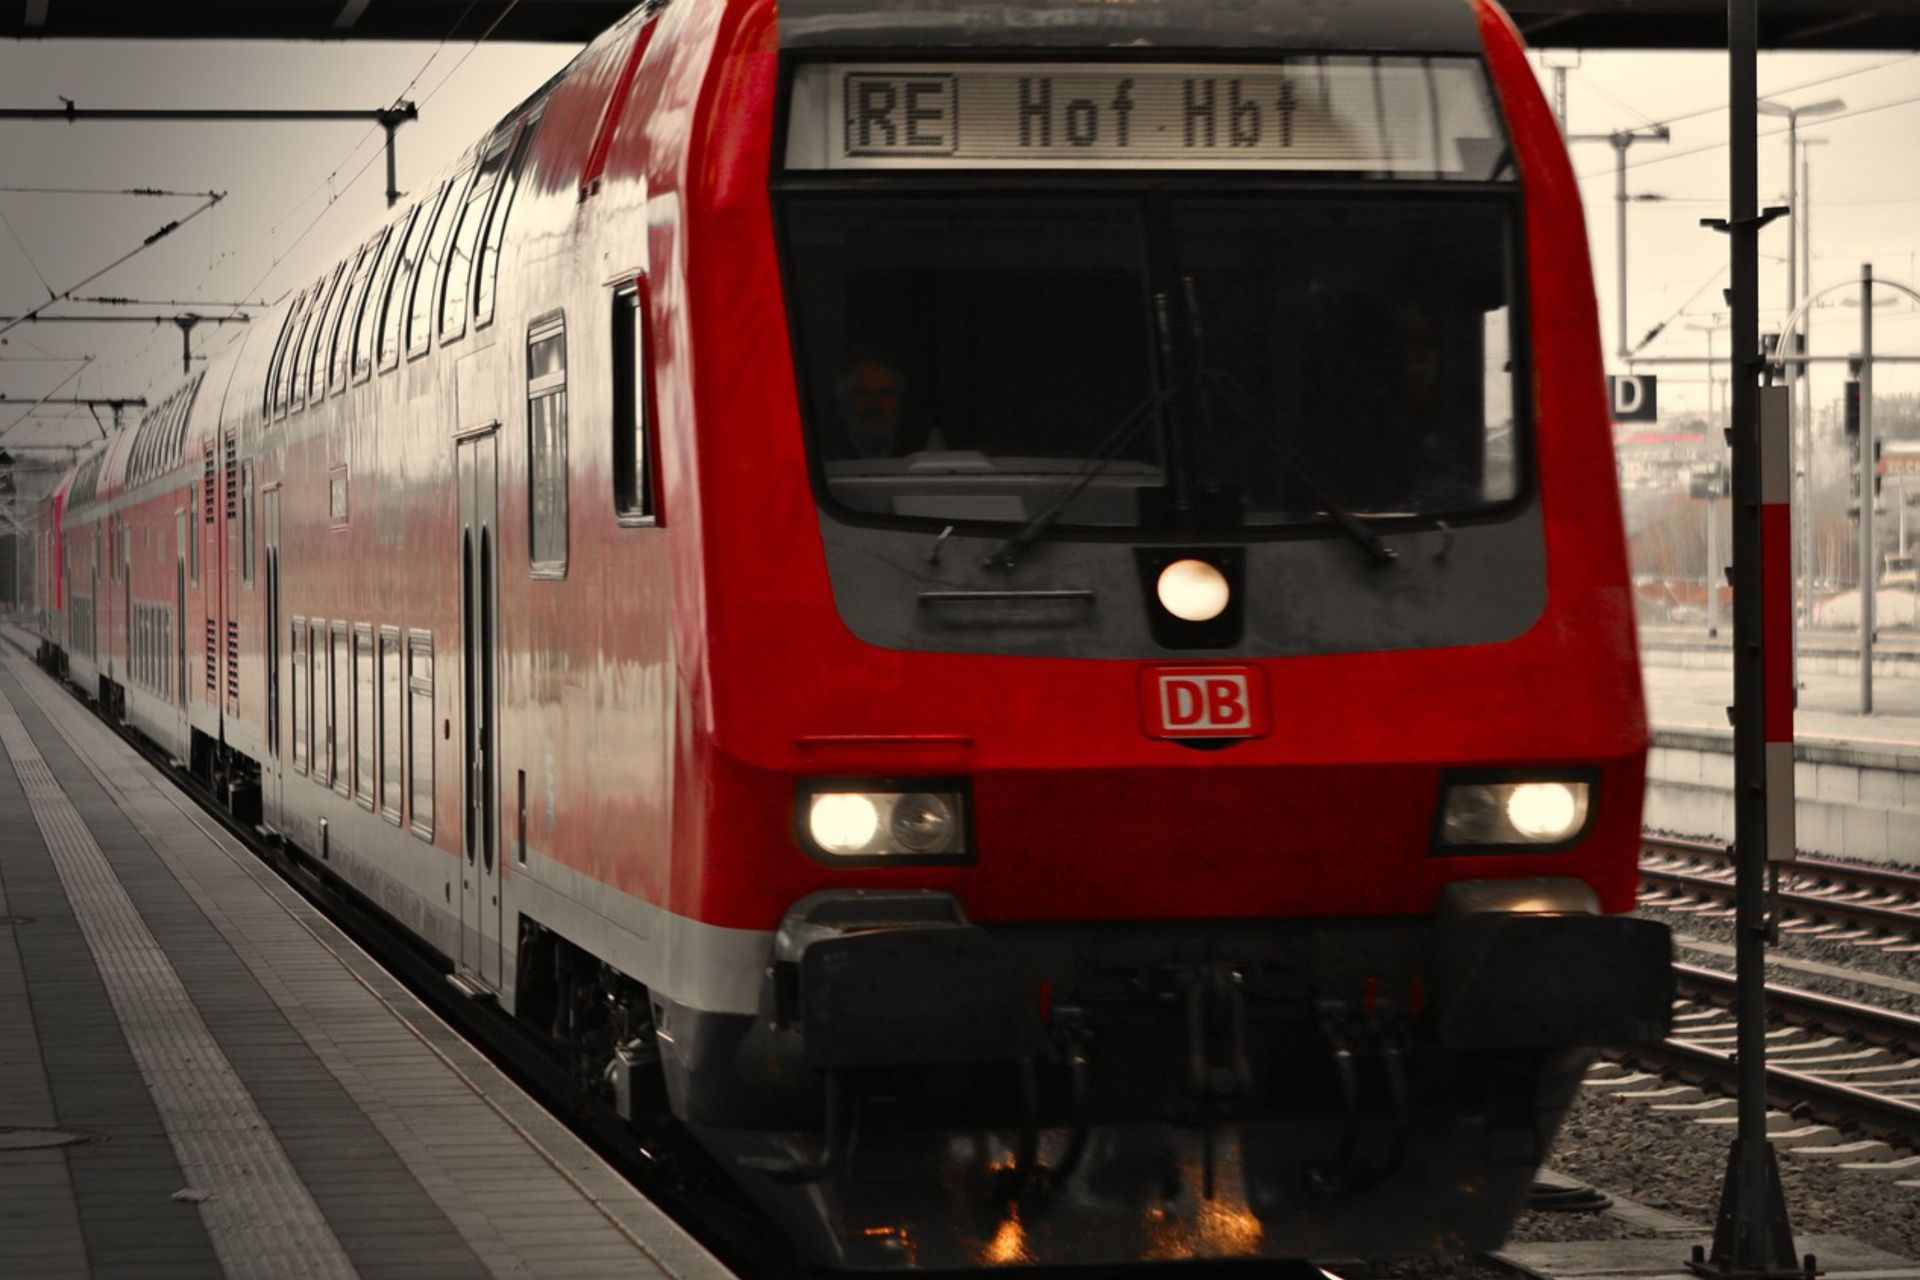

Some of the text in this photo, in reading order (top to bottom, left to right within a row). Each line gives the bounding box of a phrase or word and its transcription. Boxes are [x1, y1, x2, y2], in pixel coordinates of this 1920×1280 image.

[858, 81, 944, 147] RE
[1018, 77, 1135, 147] Hof
[1614, 375, 1643, 413] D
[1164, 679, 1244, 726] DB
